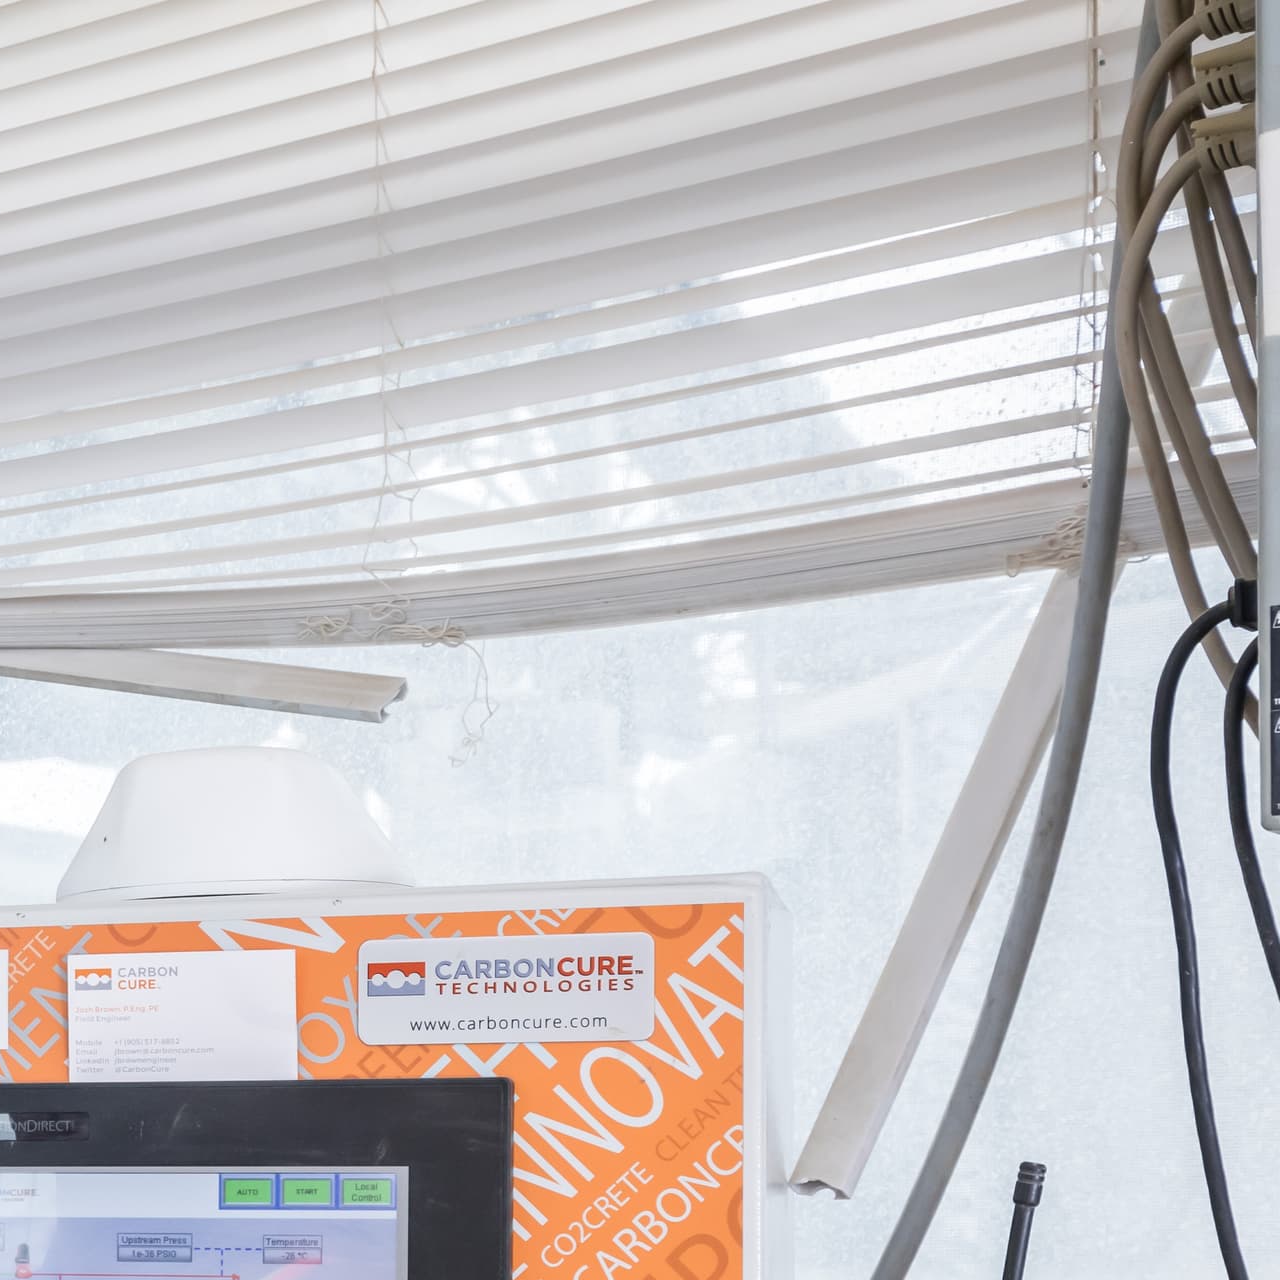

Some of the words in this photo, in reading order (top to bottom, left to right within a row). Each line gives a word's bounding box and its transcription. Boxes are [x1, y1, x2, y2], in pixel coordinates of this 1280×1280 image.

[8, 930, 57, 992] RETE
[118, 966, 179, 978] CARBON
[436, 978, 635, 996] TECHNOLOGIES
[409, 1014, 608, 1032] www.carboncure.com
[512, 914, 743, 1242] NNOVAT
[655, 1089, 731, 1162] CLEAN
[237, 1188, 259, 1197] AUTO
[296, 1188, 318, 1196] START
[355, 1183, 378, 1192] Local
[351, 1194, 382, 1202] Control
[541, 1161, 654, 1268] CO2CRETE
[121, 1236, 161, 1247] Upstream
[164, 1236, 187, 1245] Press
[266, 1238, 319, 1248] Temperature
